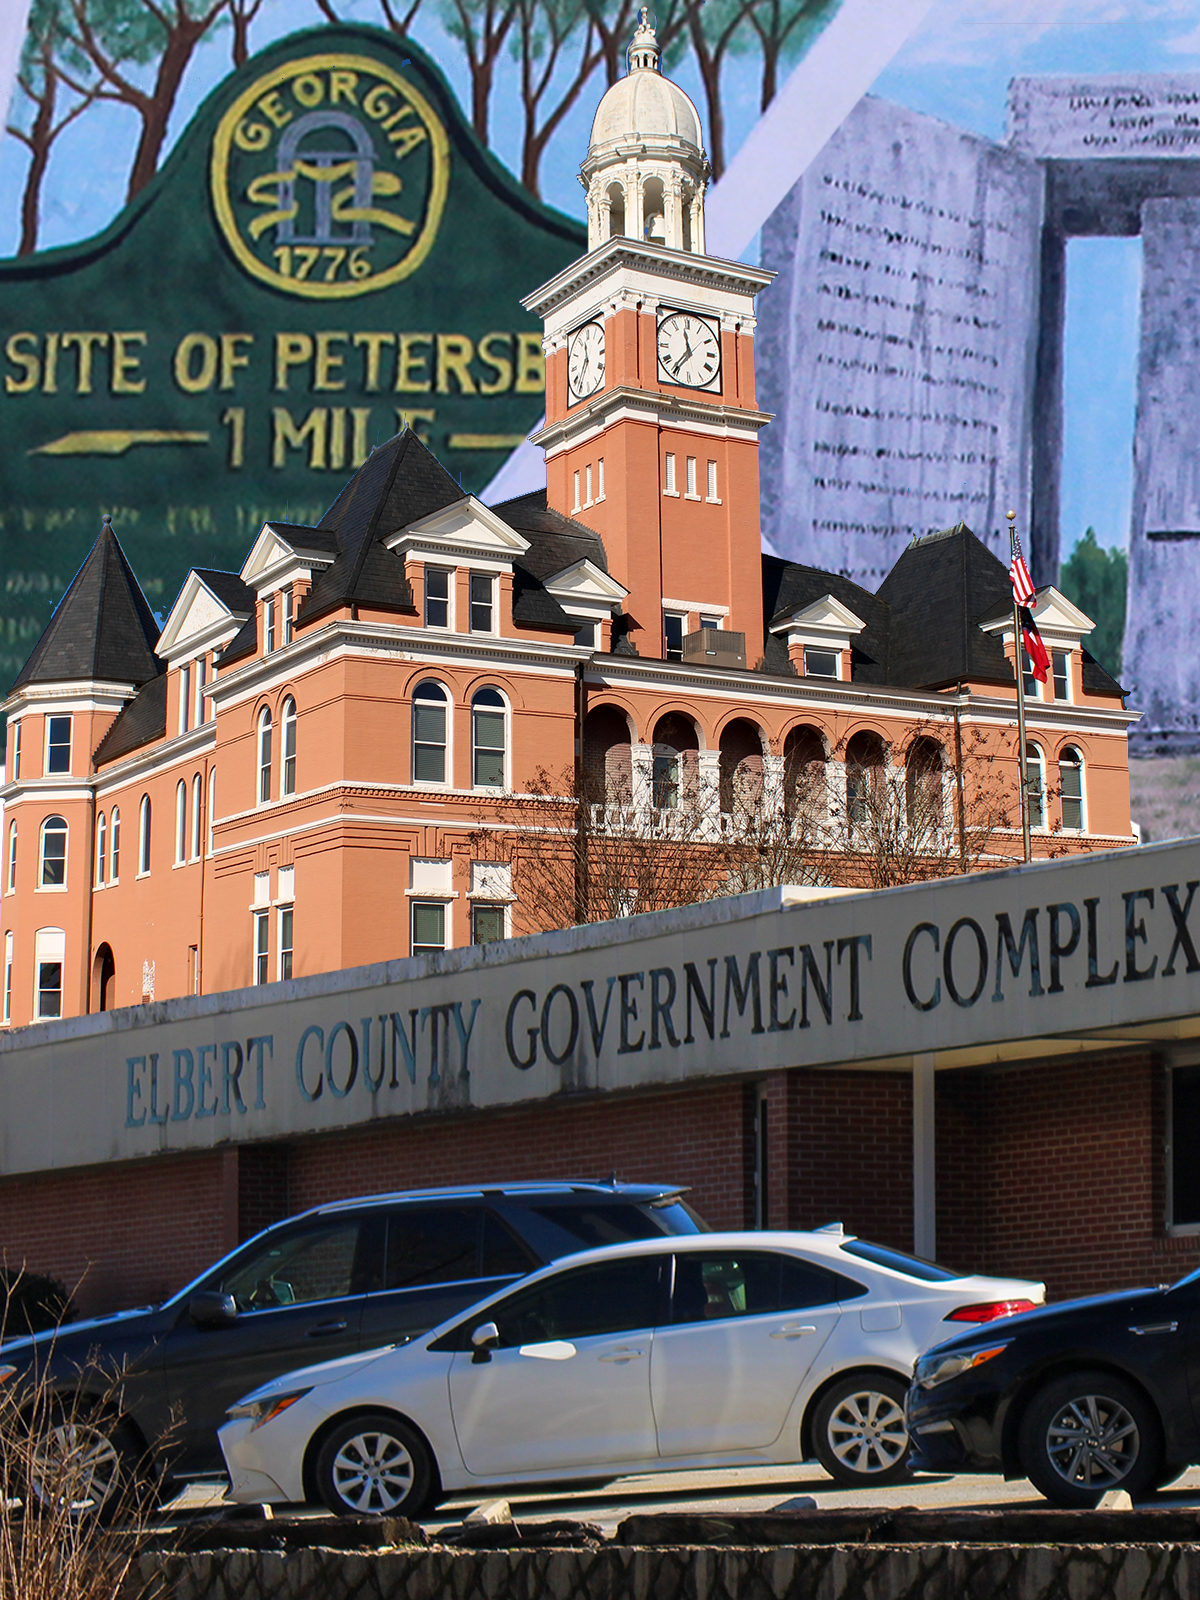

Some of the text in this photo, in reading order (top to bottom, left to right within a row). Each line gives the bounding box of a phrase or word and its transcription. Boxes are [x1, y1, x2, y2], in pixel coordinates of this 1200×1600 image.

[233, 71, 428, 158] GEORGIA
[273, 246, 371, 280] 1776
[5, 332, 147, 392] SITE
[174, 332, 254, 392] OF
[275, 331, 546, 394] PETERSB
[222, 407, 245, 467] 1
[124, 1034, 274, 1128] ELBERT
[296, 998, 481, 1101] COUNTY
[505, 933, 873, 1071] GOVERNMENT
